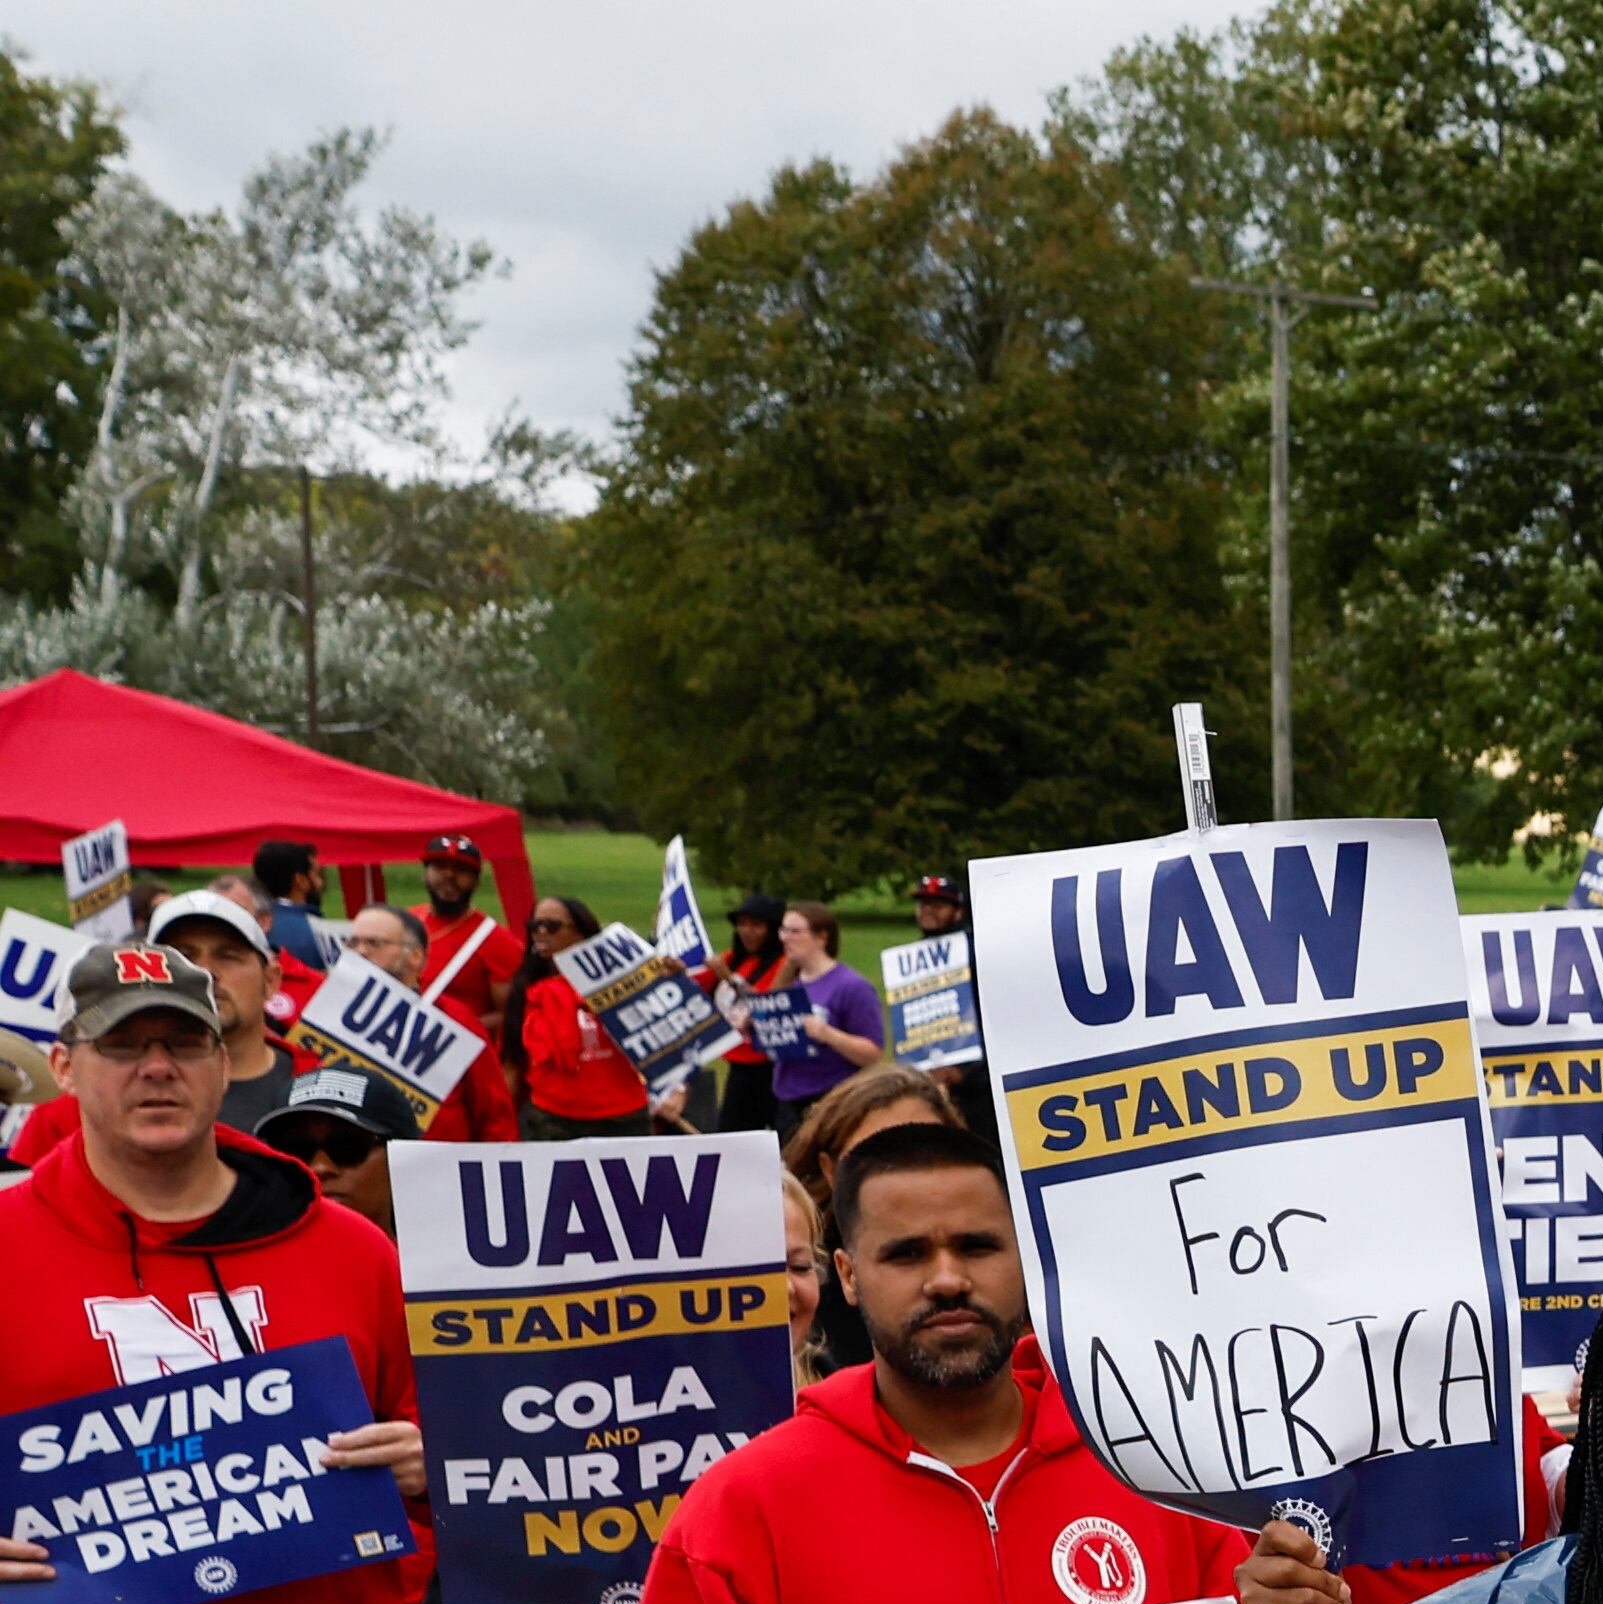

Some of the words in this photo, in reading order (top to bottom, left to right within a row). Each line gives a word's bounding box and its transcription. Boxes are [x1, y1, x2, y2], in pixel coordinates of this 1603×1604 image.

[75, 832, 114, 883] UAW
[113, 949, 173, 983] N
[572, 932, 643, 982] UAW
[898, 941, 951, 976] UAW
[1051, 841, 1369, 1026] UAW
[341, 976, 457, 1077] UAW
[617, 981, 683, 1033] END
[622, 994, 713, 1060] TIERS
[1037, 1057, 1301, 1152] STAND
[1329, 1037, 1444, 1101] UP
[458, 1153, 721, 1268] UAW
[1169, 1172, 1327, 1295] For
[84, 1286, 268, 1385] N
[432, 1294, 657, 1347] STAND
[679, 1285, 767, 1324] UP
[1545, 1295, 1583, 1310] 2ND
[18, 1368, 294, 1474] SAVING
[502, 1365, 716, 1434] COLA
[1090, 1300, 1499, 1493] AMERICA
[134, 1435, 205, 1472] THE
[584, 1427, 641, 1451] AND
[444, 1453, 625, 1506] FAIR
[76, 1483, 315, 1575] DREAM
